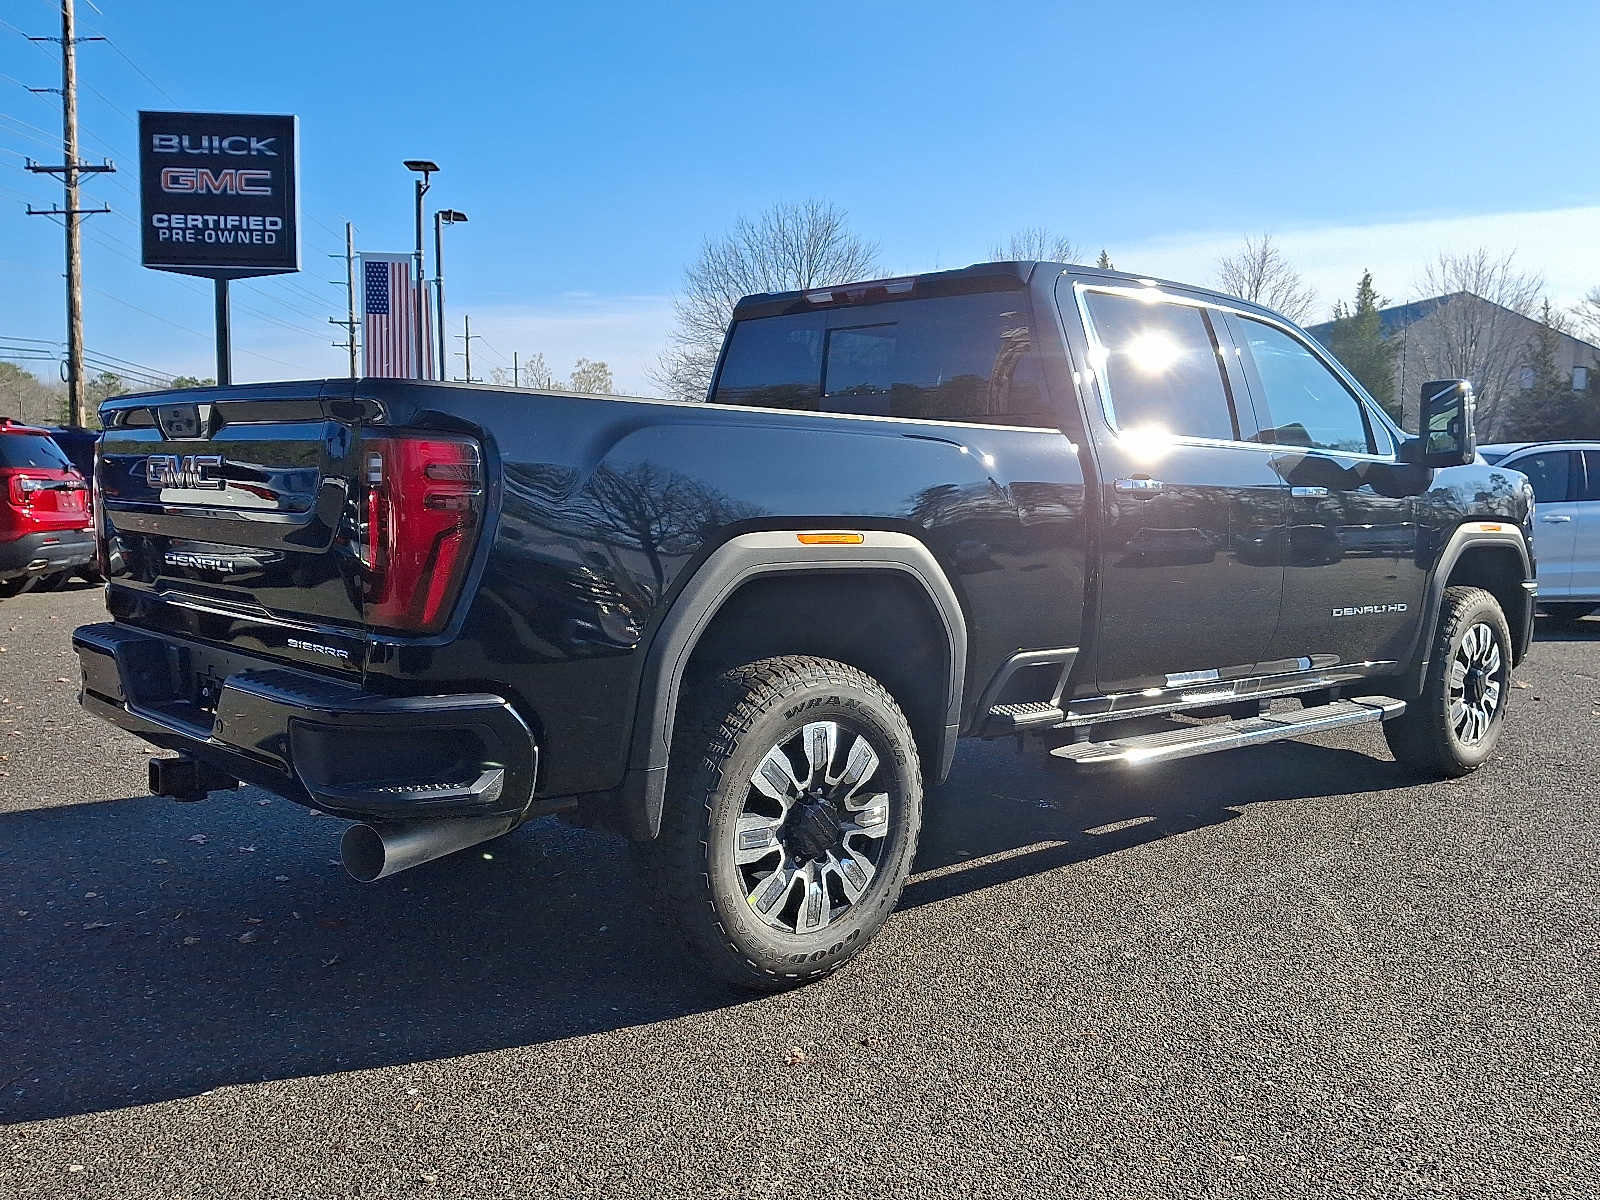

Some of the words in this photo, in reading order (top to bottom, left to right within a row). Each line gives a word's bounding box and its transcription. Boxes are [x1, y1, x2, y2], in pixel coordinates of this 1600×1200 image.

[152, 134, 278, 156] BUICK
[161, 167, 272, 195] GMC
[152, 213, 282, 230] CERTIFIED
[158, 229, 276, 244] PRE-OWNED
[146, 455, 223, 489] GMC
[164, 552, 233, 573] DENALI
[1331, 604, 1386, 617] DENALI
[1387, 603, 1408, 612] HD
[287, 638, 349, 659] SIERRA
